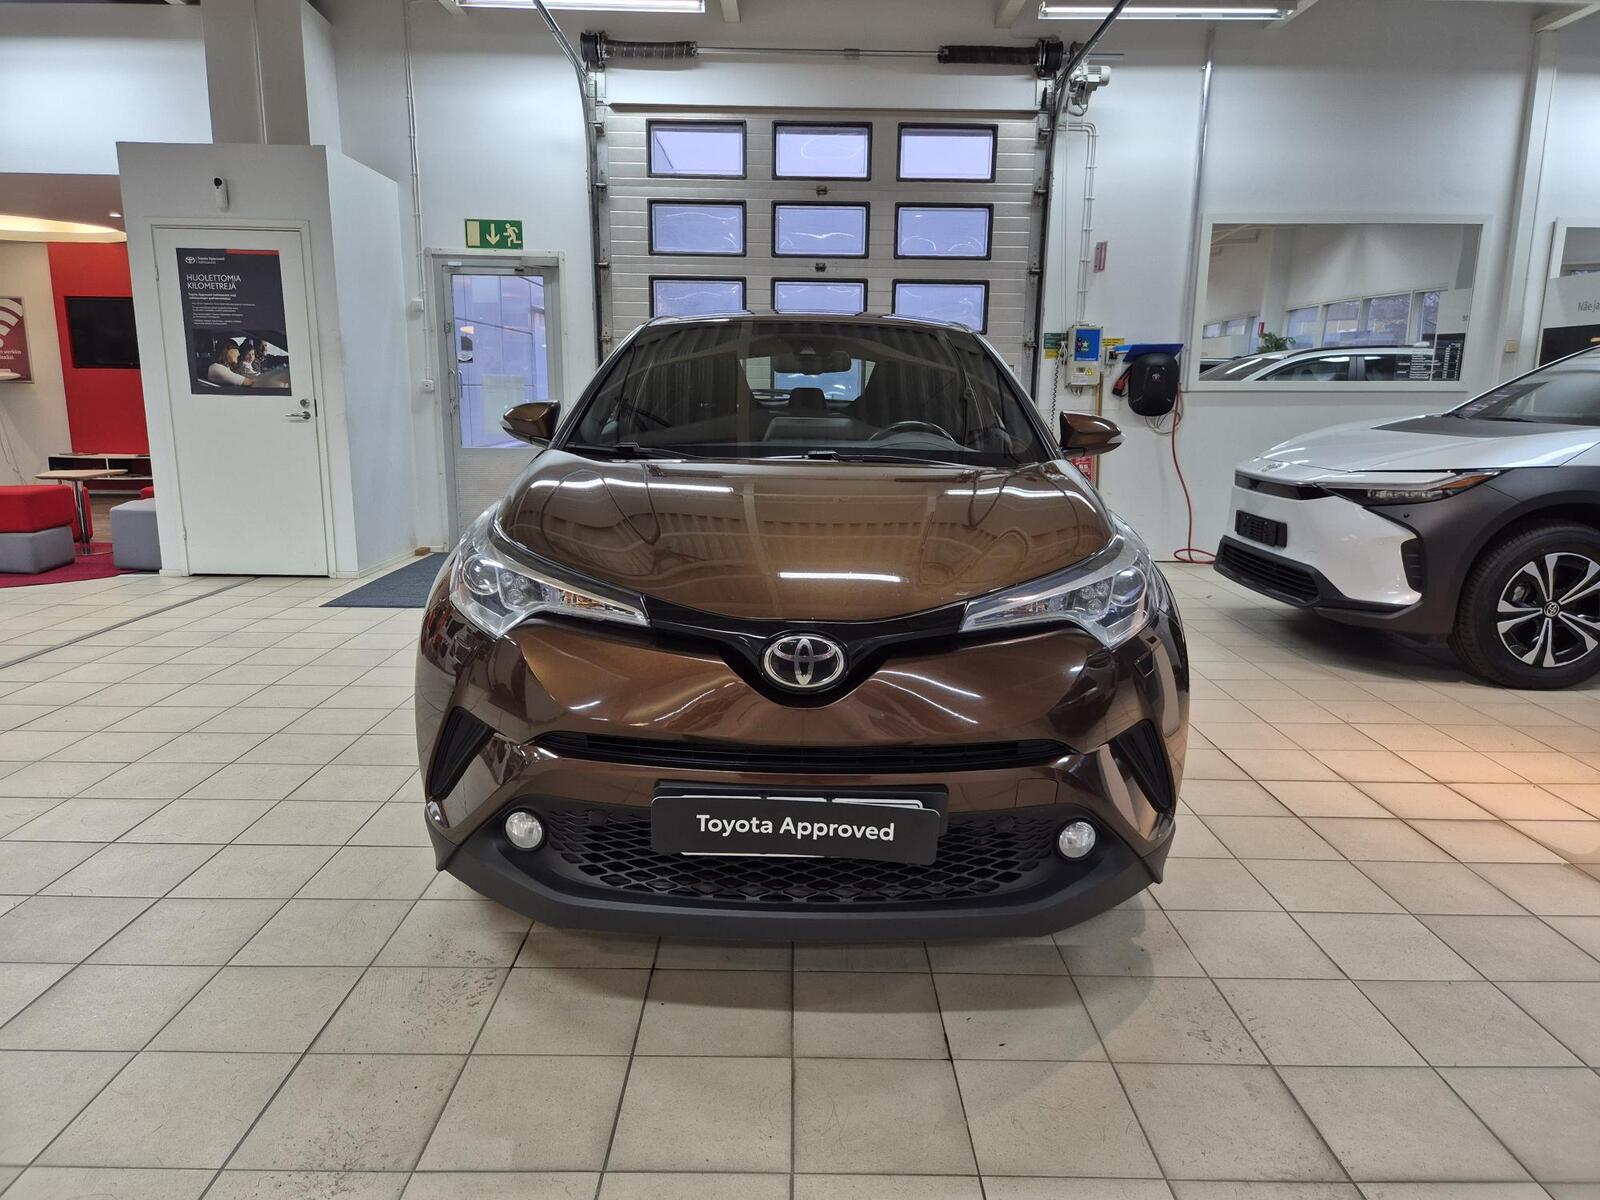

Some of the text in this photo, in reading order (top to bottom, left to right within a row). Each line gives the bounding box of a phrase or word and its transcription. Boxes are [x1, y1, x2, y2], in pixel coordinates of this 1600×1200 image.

[187, 274, 242, 282] HUOLETTOMIA
[696, 814, 895, 842] Toyota Approved
